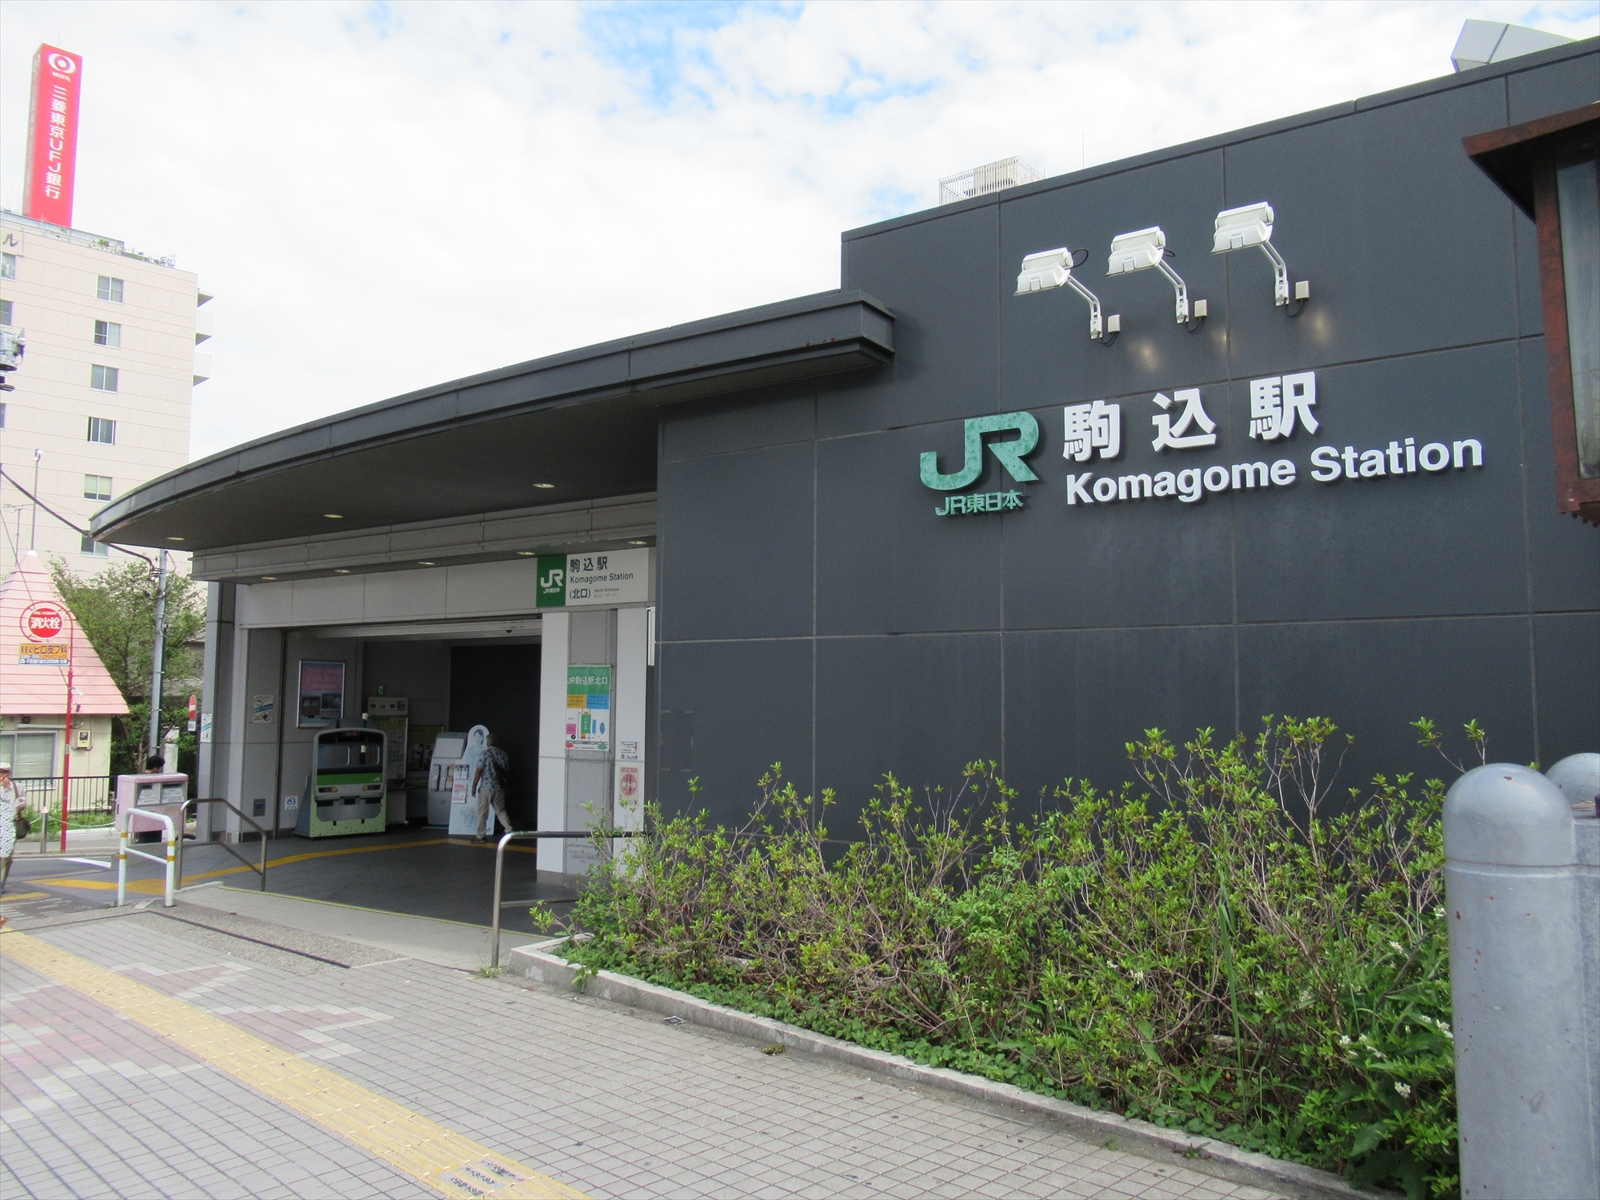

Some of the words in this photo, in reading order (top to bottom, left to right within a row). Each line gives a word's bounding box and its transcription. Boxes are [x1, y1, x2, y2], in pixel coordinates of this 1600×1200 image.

[45, 84, 68, 200] 三菱東京UFJ銀行
[1062, 371, 1320, 462] 駒込駅
[919, 411, 1040, 492] JR
[1066, 458, 1297, 506] Komagome
[1310, 438, 1484, 484] Station
[935, 491, 1024, 517] JR東日本
[569, 556, 608, 573] 駒込駅
[540, 569, 564, 588] JR
[570, 575, 607, 584] Komagome
[609, 572, 633, 581] Station
[30, 617, 61, 629] 消火栓
